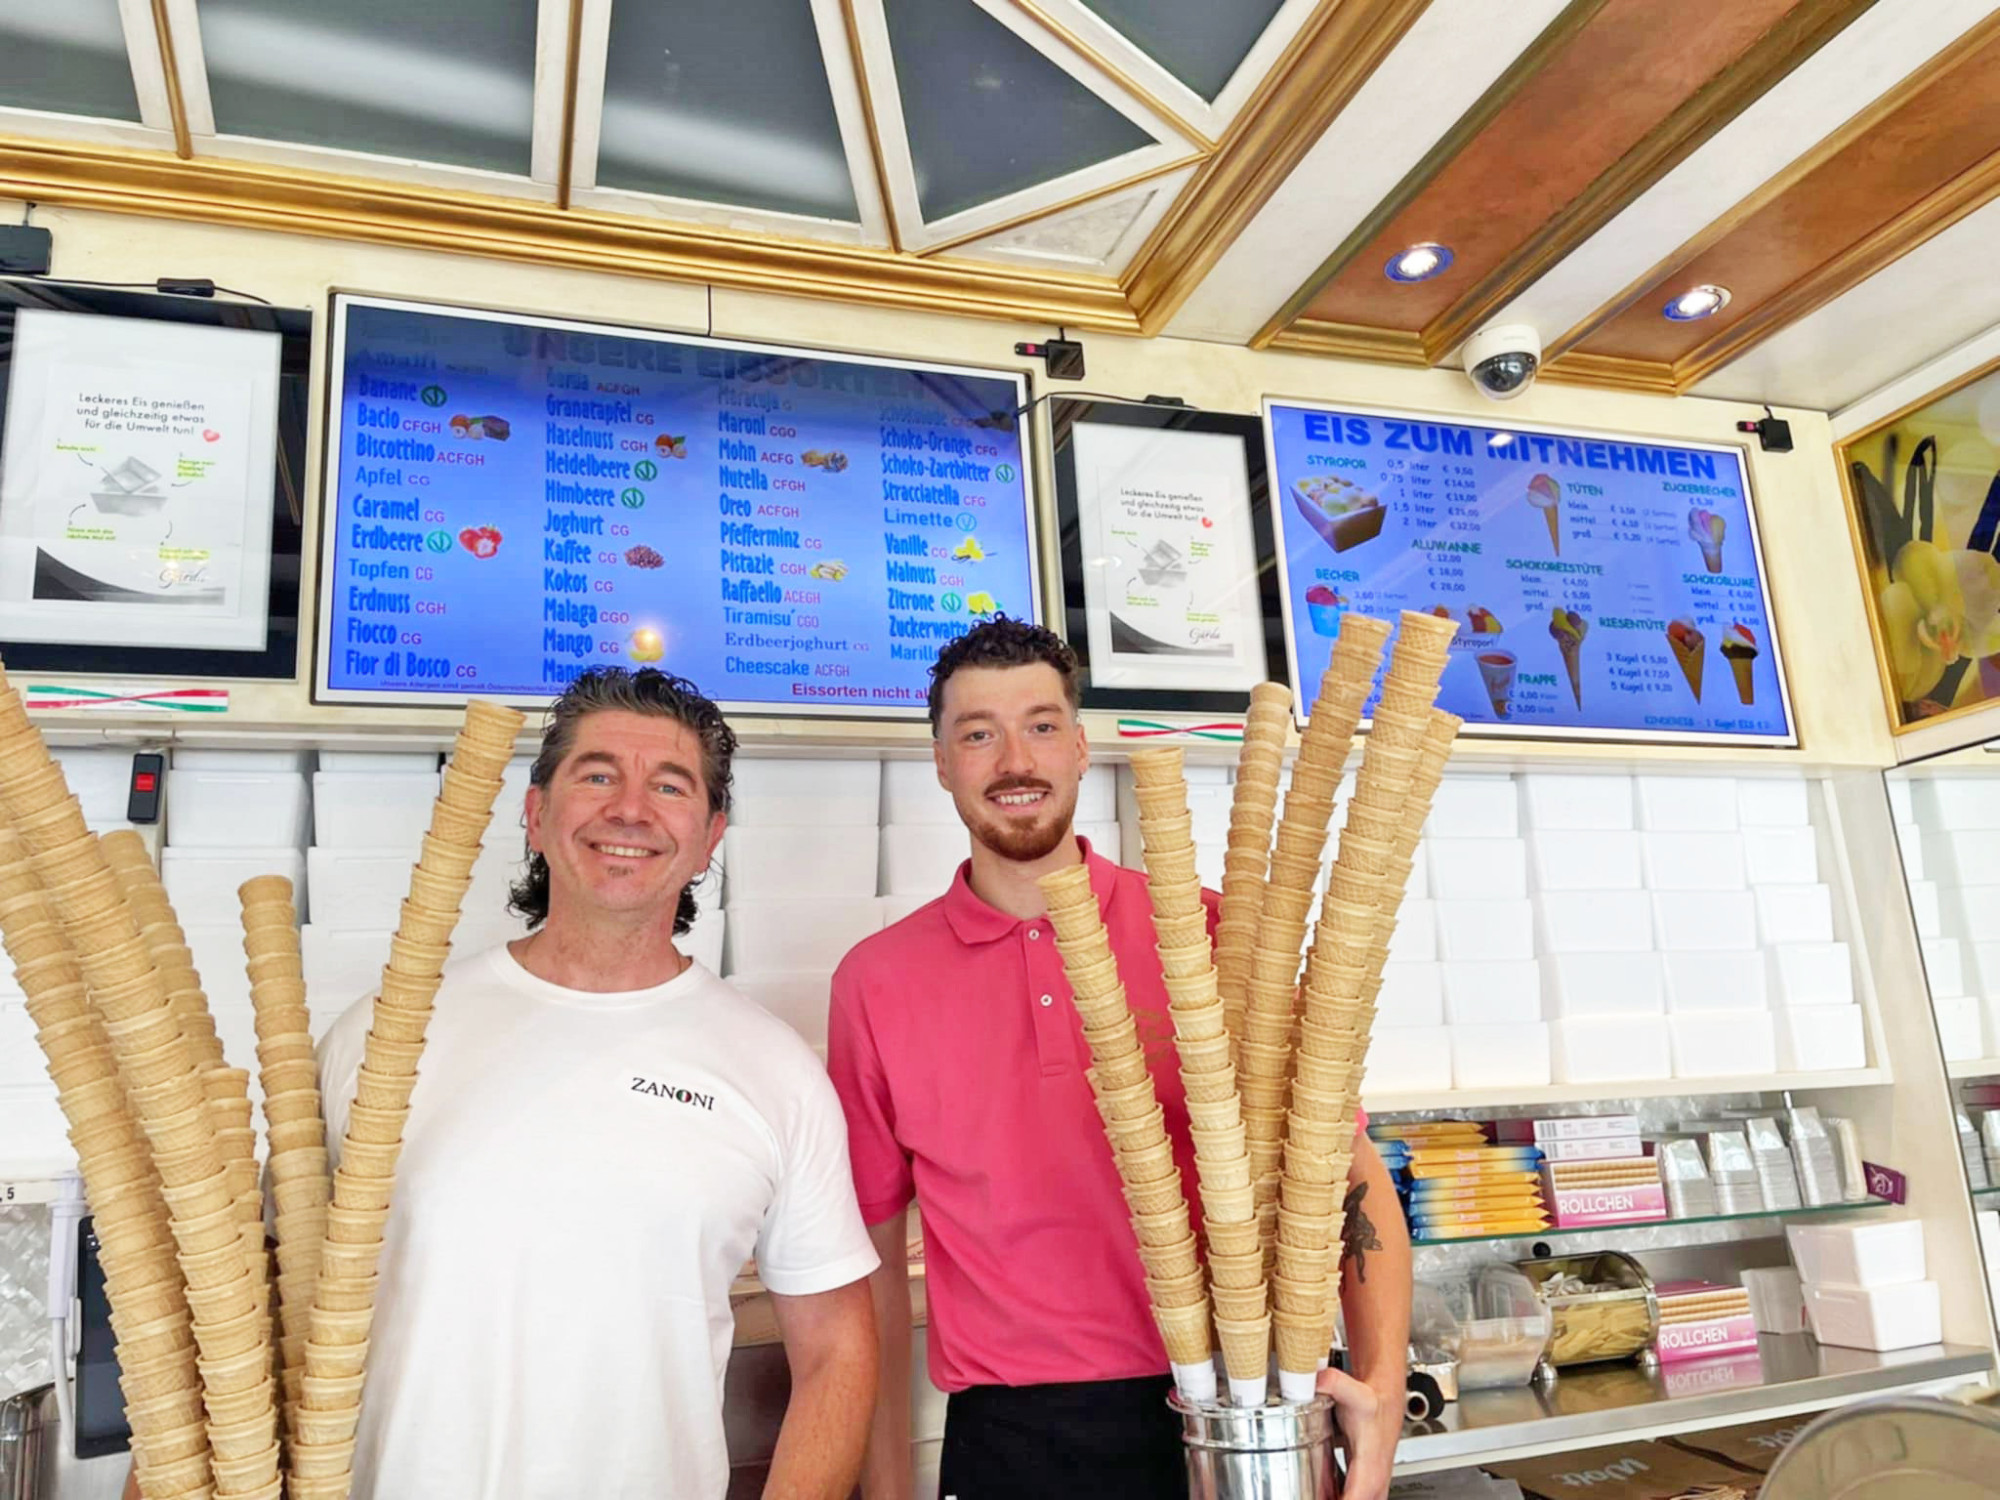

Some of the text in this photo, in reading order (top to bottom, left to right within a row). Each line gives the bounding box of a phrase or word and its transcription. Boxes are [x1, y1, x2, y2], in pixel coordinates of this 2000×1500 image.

[359, 374, 417, 402] Banane
[77, 406, 205, 424] und gleichzeitig etwas
[79, 393, 204, 411] Leckeres Eis genießen
[546, 394, 655, 427] Granatapfel CG
[85, 418, 195, 435] für die Umwelt tun!
[357, 402, 441, 433] Bacio CFGH
[718, 411, 796, 438] Maroni CGO
[356, 432, 485, 466] Biscottino ACFGH
[546, 422, 648, 452] Haselnuss CGH
[881, 427, 998, 458] Schoko-Orange CFG
[1304, 414, 1716, 480] EIS ZUM MITNEHMEN
[719, 438, 794, 465] Mohn ACFG
[1306, 455, 1366, 469] STYROPOR
[356, 466, 430, 487] Apfel CG
[546, 451, 630, 480] Heidelbeere
[720, 465, 806, 492] Nutella CFGH
[882, 453, 991, 482] Schoko-Zartbitter
[1410, 461, 1430, 472] liter
[545, 480, 615, 507] Himbeere
[883, 479, 986, 507] Stracciatella CFG
[1411, 475, 1431, 486] liter
[1566, 481, 1604, 496] TÜTEN
[720, 494, 799, 518] Oreo ACFGH
[1413, 489, 1434, 500] liter
[353, 494, 445, 522] Caramel CG
[884, 508, 953, 528] Limette
[1415, 504, 1435, 514] liter
[544, 509, 630, 538] Joghurt CG
[720, 521, 822, 550] Pfefferminz CG
[1416, 518, 1437, 529] liter
[352, 524, 422, 552] Erdbeere
[885, 533, 948, 559] Vanille CG
[1411, 539, 1482, 554] ALUWANNE
[544, 539, 618, 565] Kaffee CG
[720, 550, 806, 575] Pistazie CGH
[349, 558, 433, 581] Topfen CG
[544, 568, 613, 594] Kokos CG
[887, 561, 964, 587] Walnuss CGH
[1315, 568, 1360, 582] BECHER
[350, 586, 446, 614] Erdnuss CGH
[721, 578, 782, 604] Raffaello
[888, 588, 935, 612] Zitrone
[544, 598, 630, 628] Malaga CGO
[1599, 617, 1666, 632] RIESENTÜTE
[348, 617, 422, 645] Fiocco CG
[888, 615, 968, 640] Zuckerwatte
[543, 628, 620, 657] Mango CG
[725, 632, 848, 652] Erdbeerjoghurt
[346, 650, 477, 678] Fior di Bosco CG
[725, 656, 810, 676] Cheescake
[1616, 653, 1639, 664] Kugel
[1618, 668, 1641, 678] Kugel
[792, 683, 930, 699] Eissorten nicht al
[1620, 683, 1644, 693] Kugel
[631, 1077, 715, 1111] ZANONI
